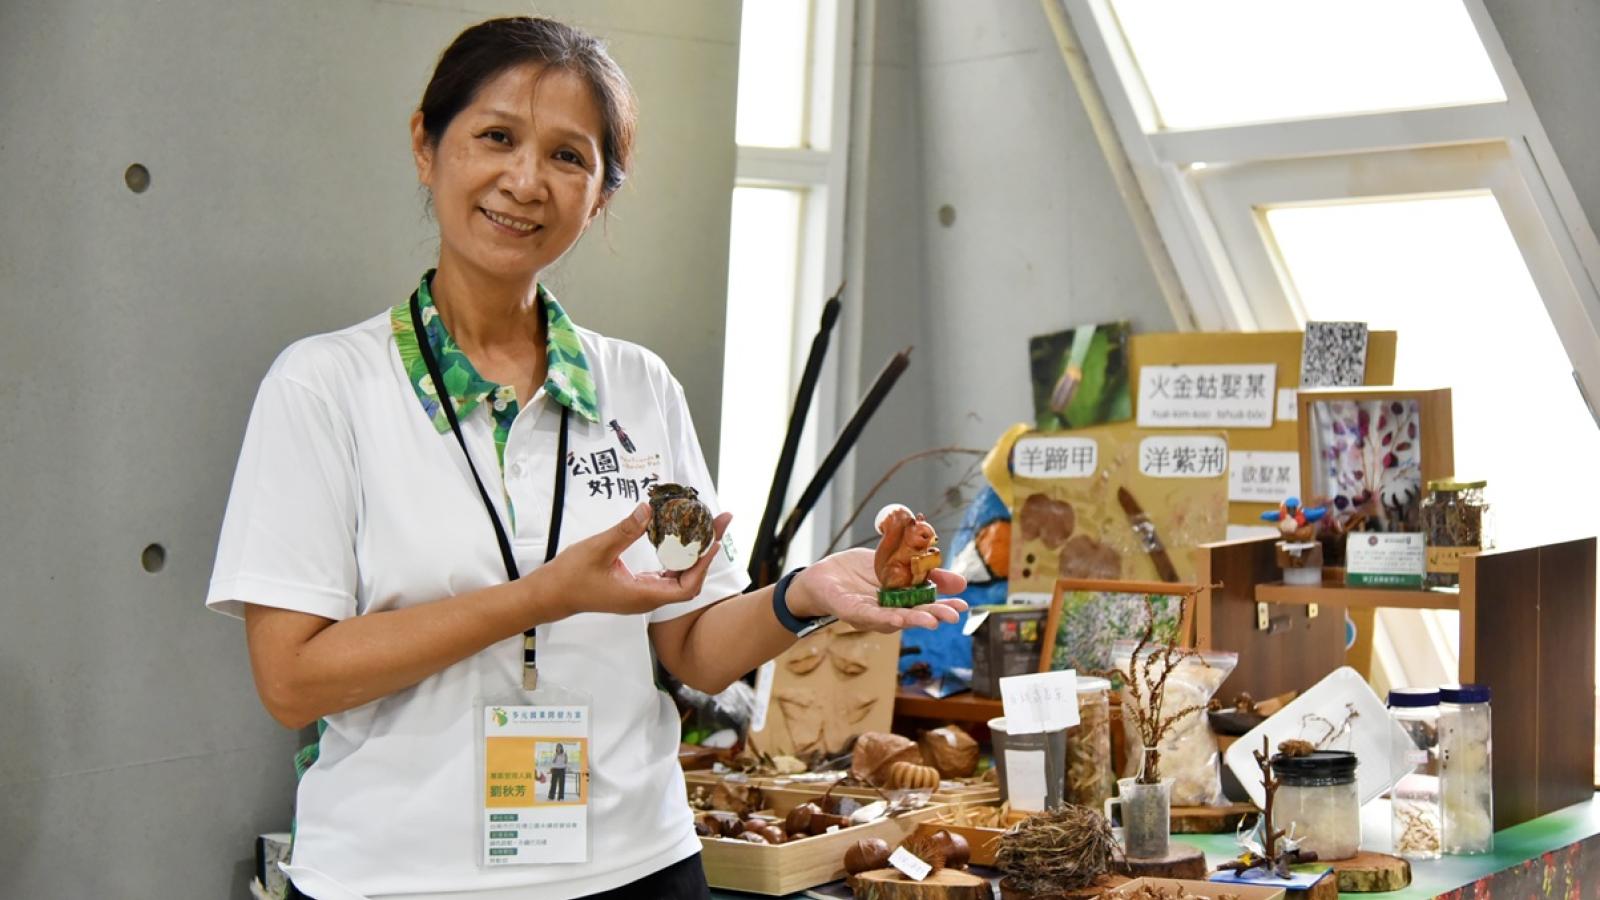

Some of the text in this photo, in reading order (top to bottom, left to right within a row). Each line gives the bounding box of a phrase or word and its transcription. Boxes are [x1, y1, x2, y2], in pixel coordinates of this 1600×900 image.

[1149, 373, 1266, 399] 火金蛄娶某
[567, 447, 620, 476] 公園
[1020, 446, 1094, 472] 羊蹄甲
[1144, 445, 1225, 474] 洋紫荊
